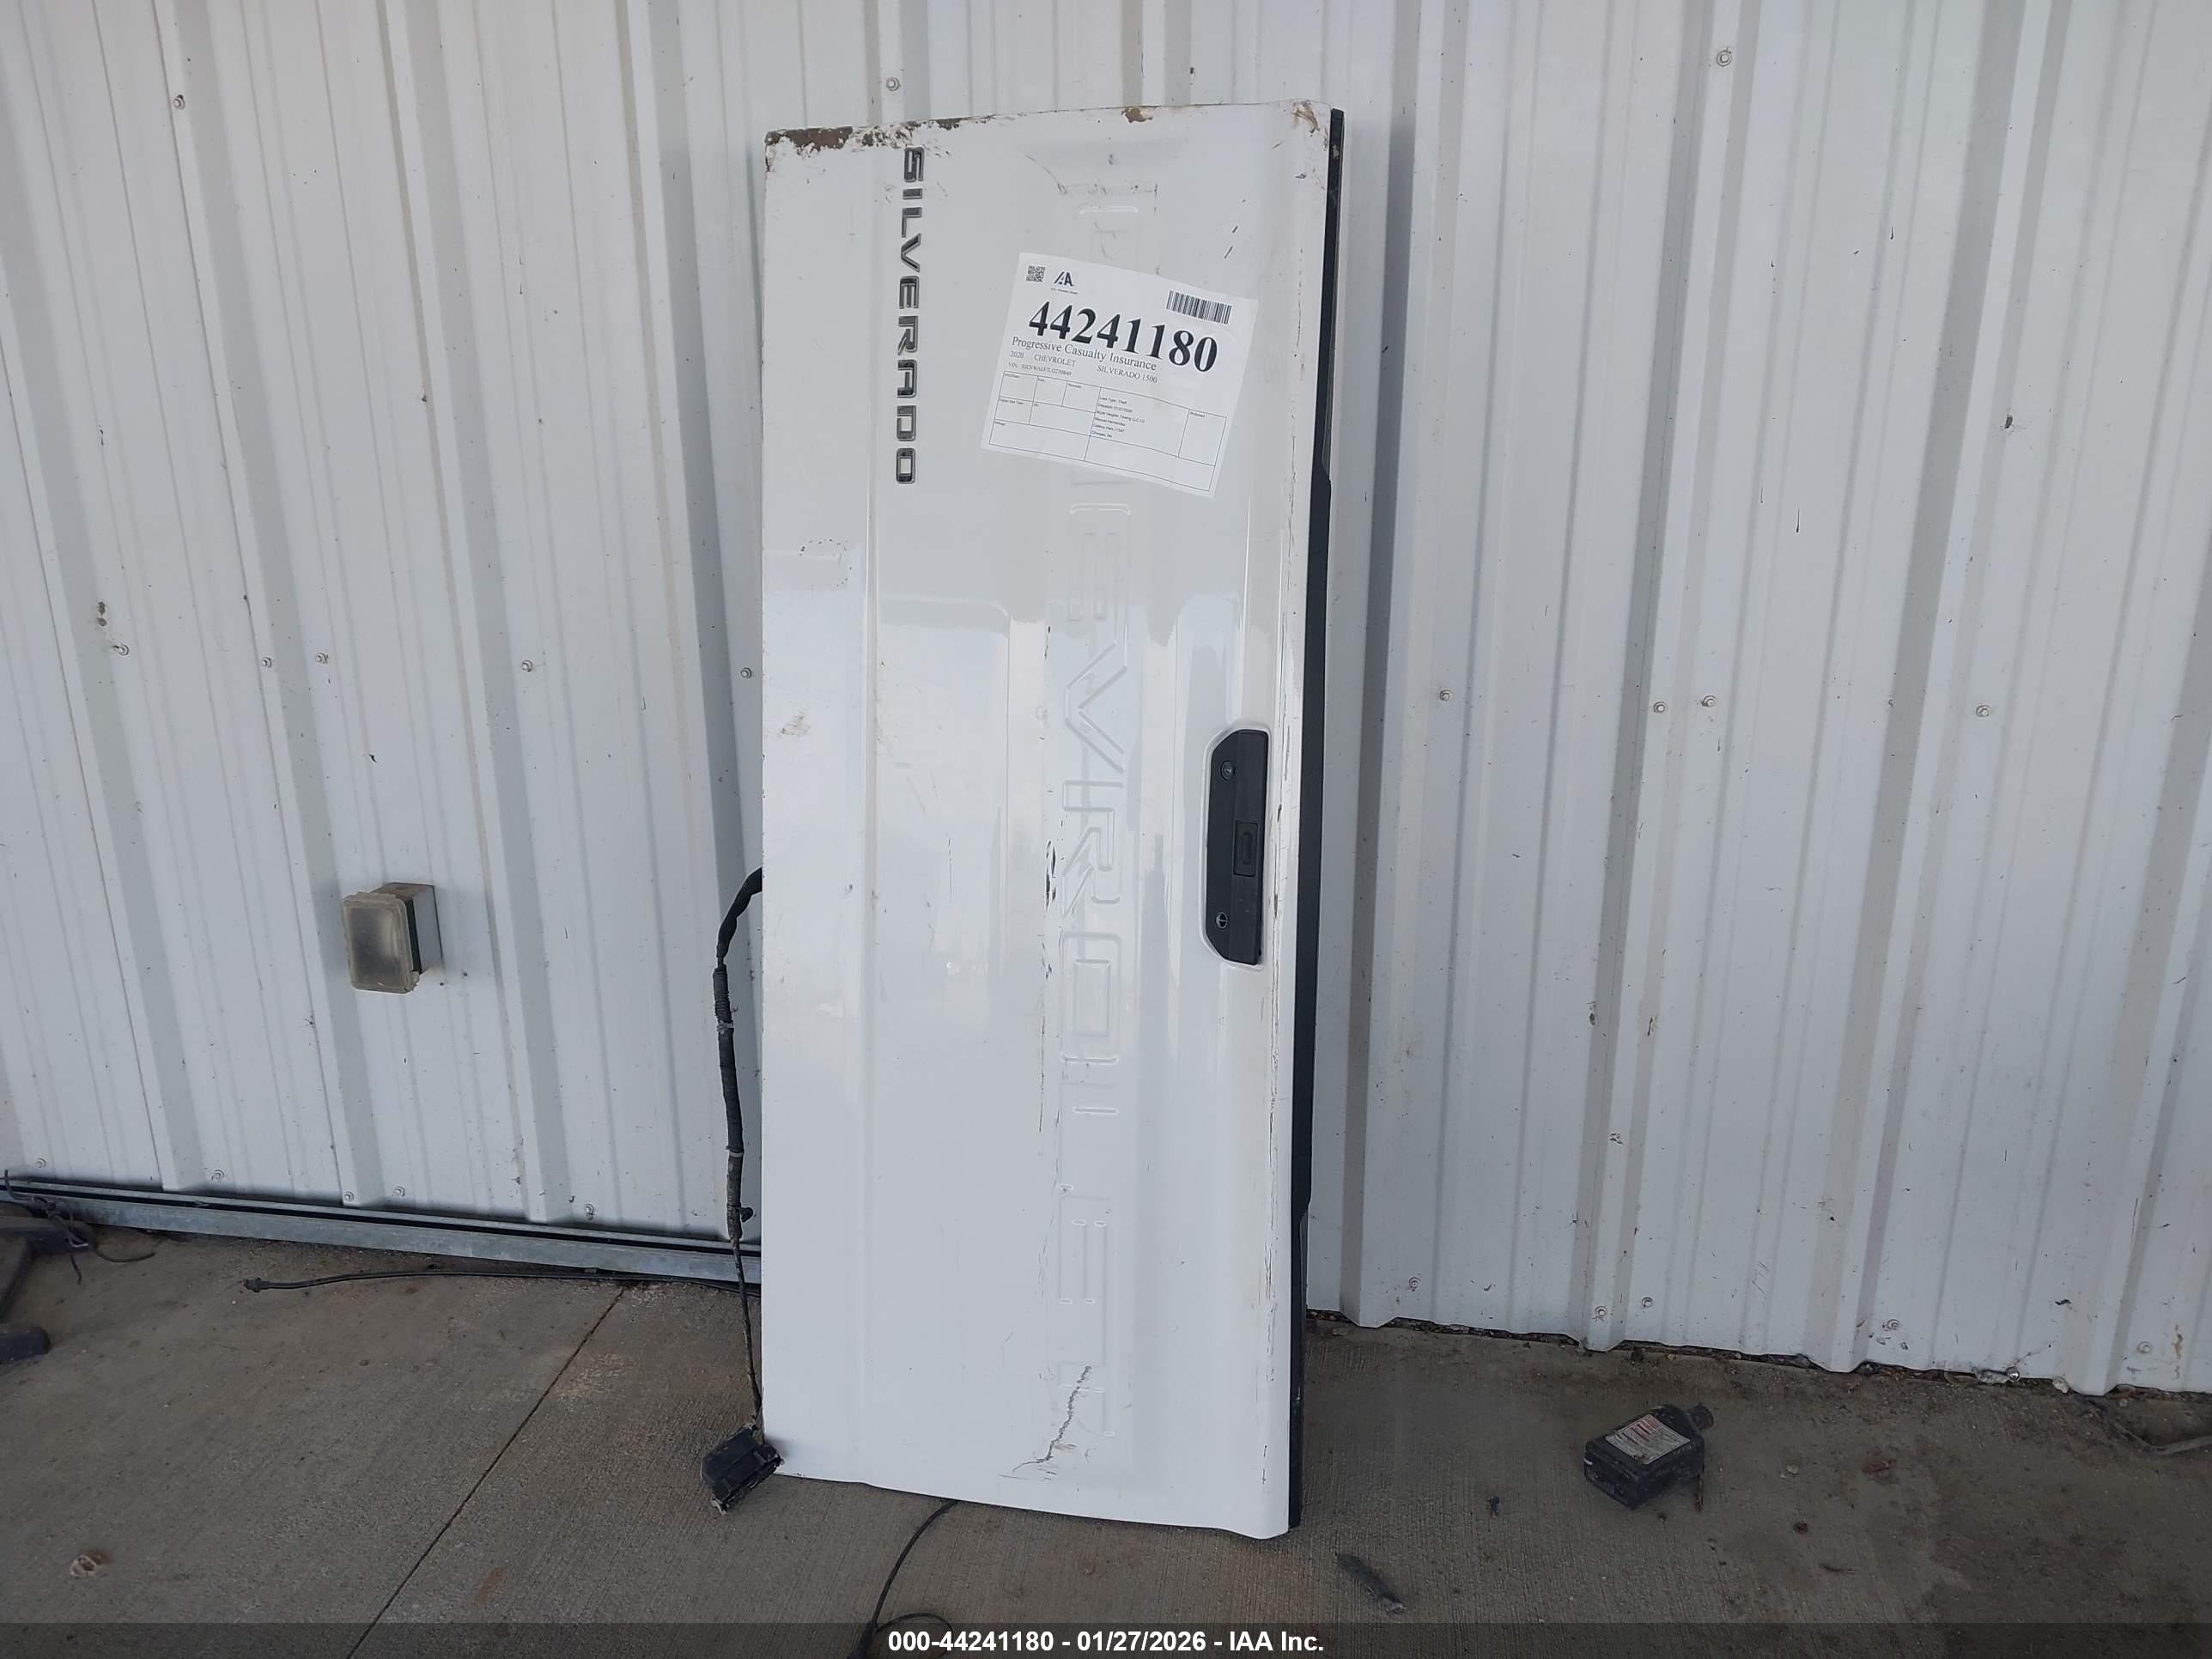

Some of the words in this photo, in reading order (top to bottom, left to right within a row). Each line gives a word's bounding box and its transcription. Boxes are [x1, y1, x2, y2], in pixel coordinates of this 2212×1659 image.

[896, 146, 925, 484] SILVERADO
[1029, 301, 1218, 373] 44241180
[1010, 350, 1024, 359] 2020
[1034, 354, 1077, 367] CHEVROLET
[1097, 365, 1141, 380] SILVERADO
[1142, 374, 1158, 384] 1500
[1012, 336, 1062, 352] Progressive
[1064, 343, 1107, 362] Casualty
[1109, 352, 1158, 371] Insurance
